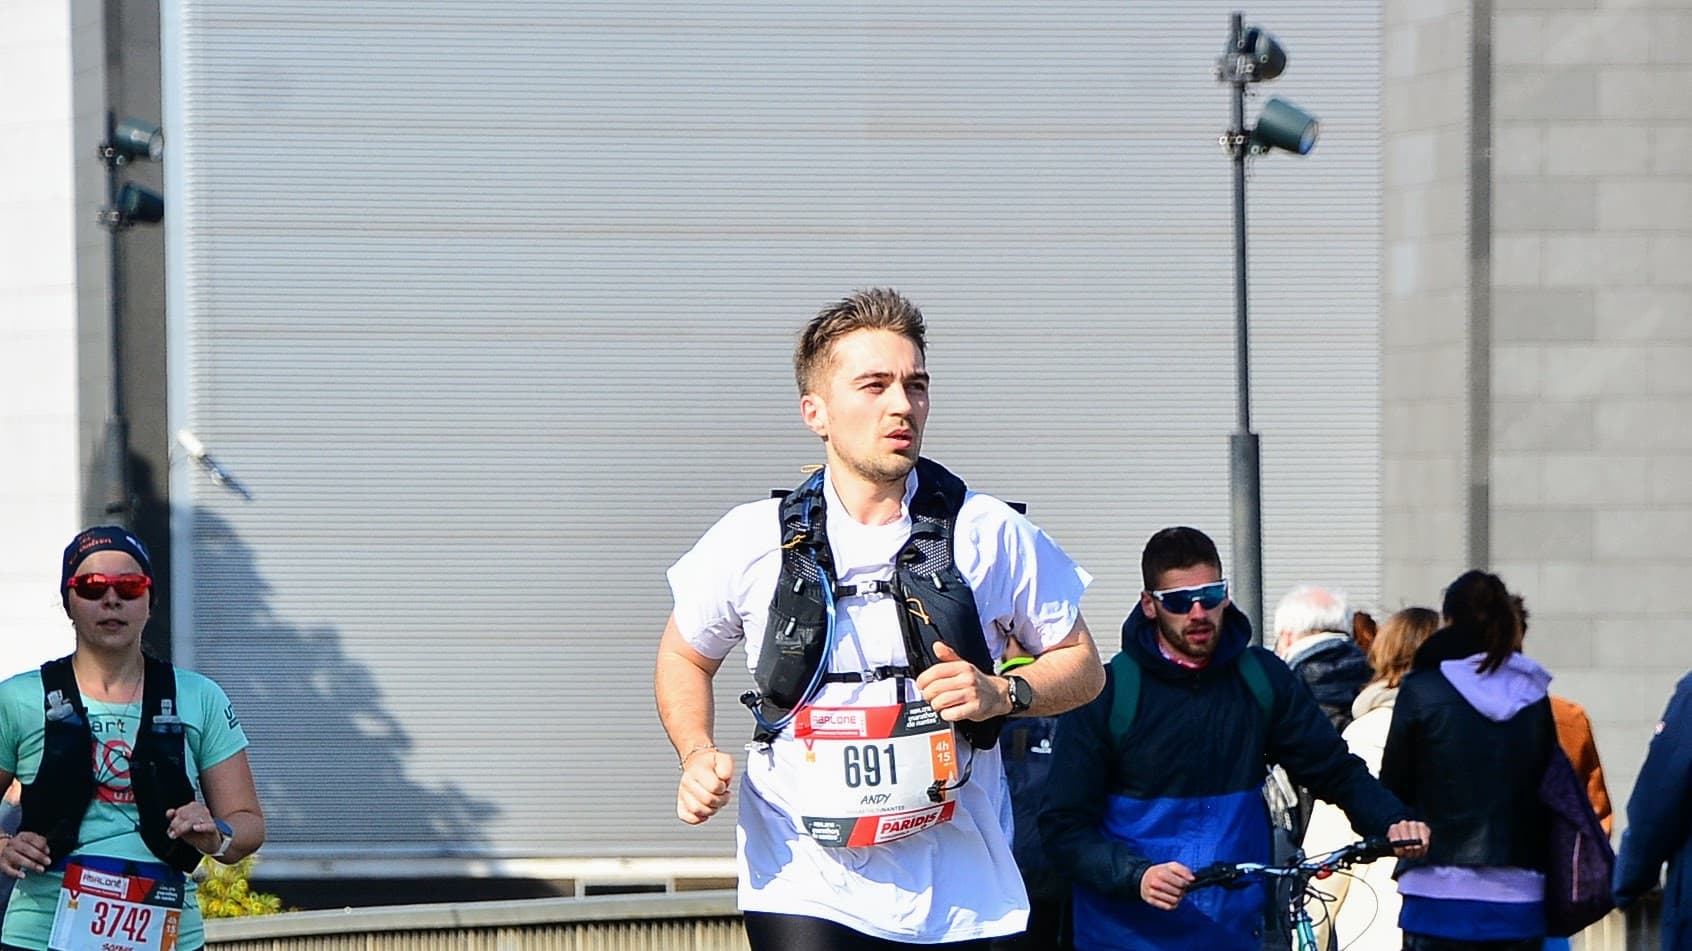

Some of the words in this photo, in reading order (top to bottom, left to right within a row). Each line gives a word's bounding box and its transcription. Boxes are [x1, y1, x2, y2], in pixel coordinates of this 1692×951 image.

[936, 740, 949, 752] 4h
[843, 743, 898, 788] 691
[937, 752, 951, 762] 15
[860, 793, 892, 805] ANDY
[880, 811, 938, 835] PARIDIS
[91, 902, 152, 943] 3742
